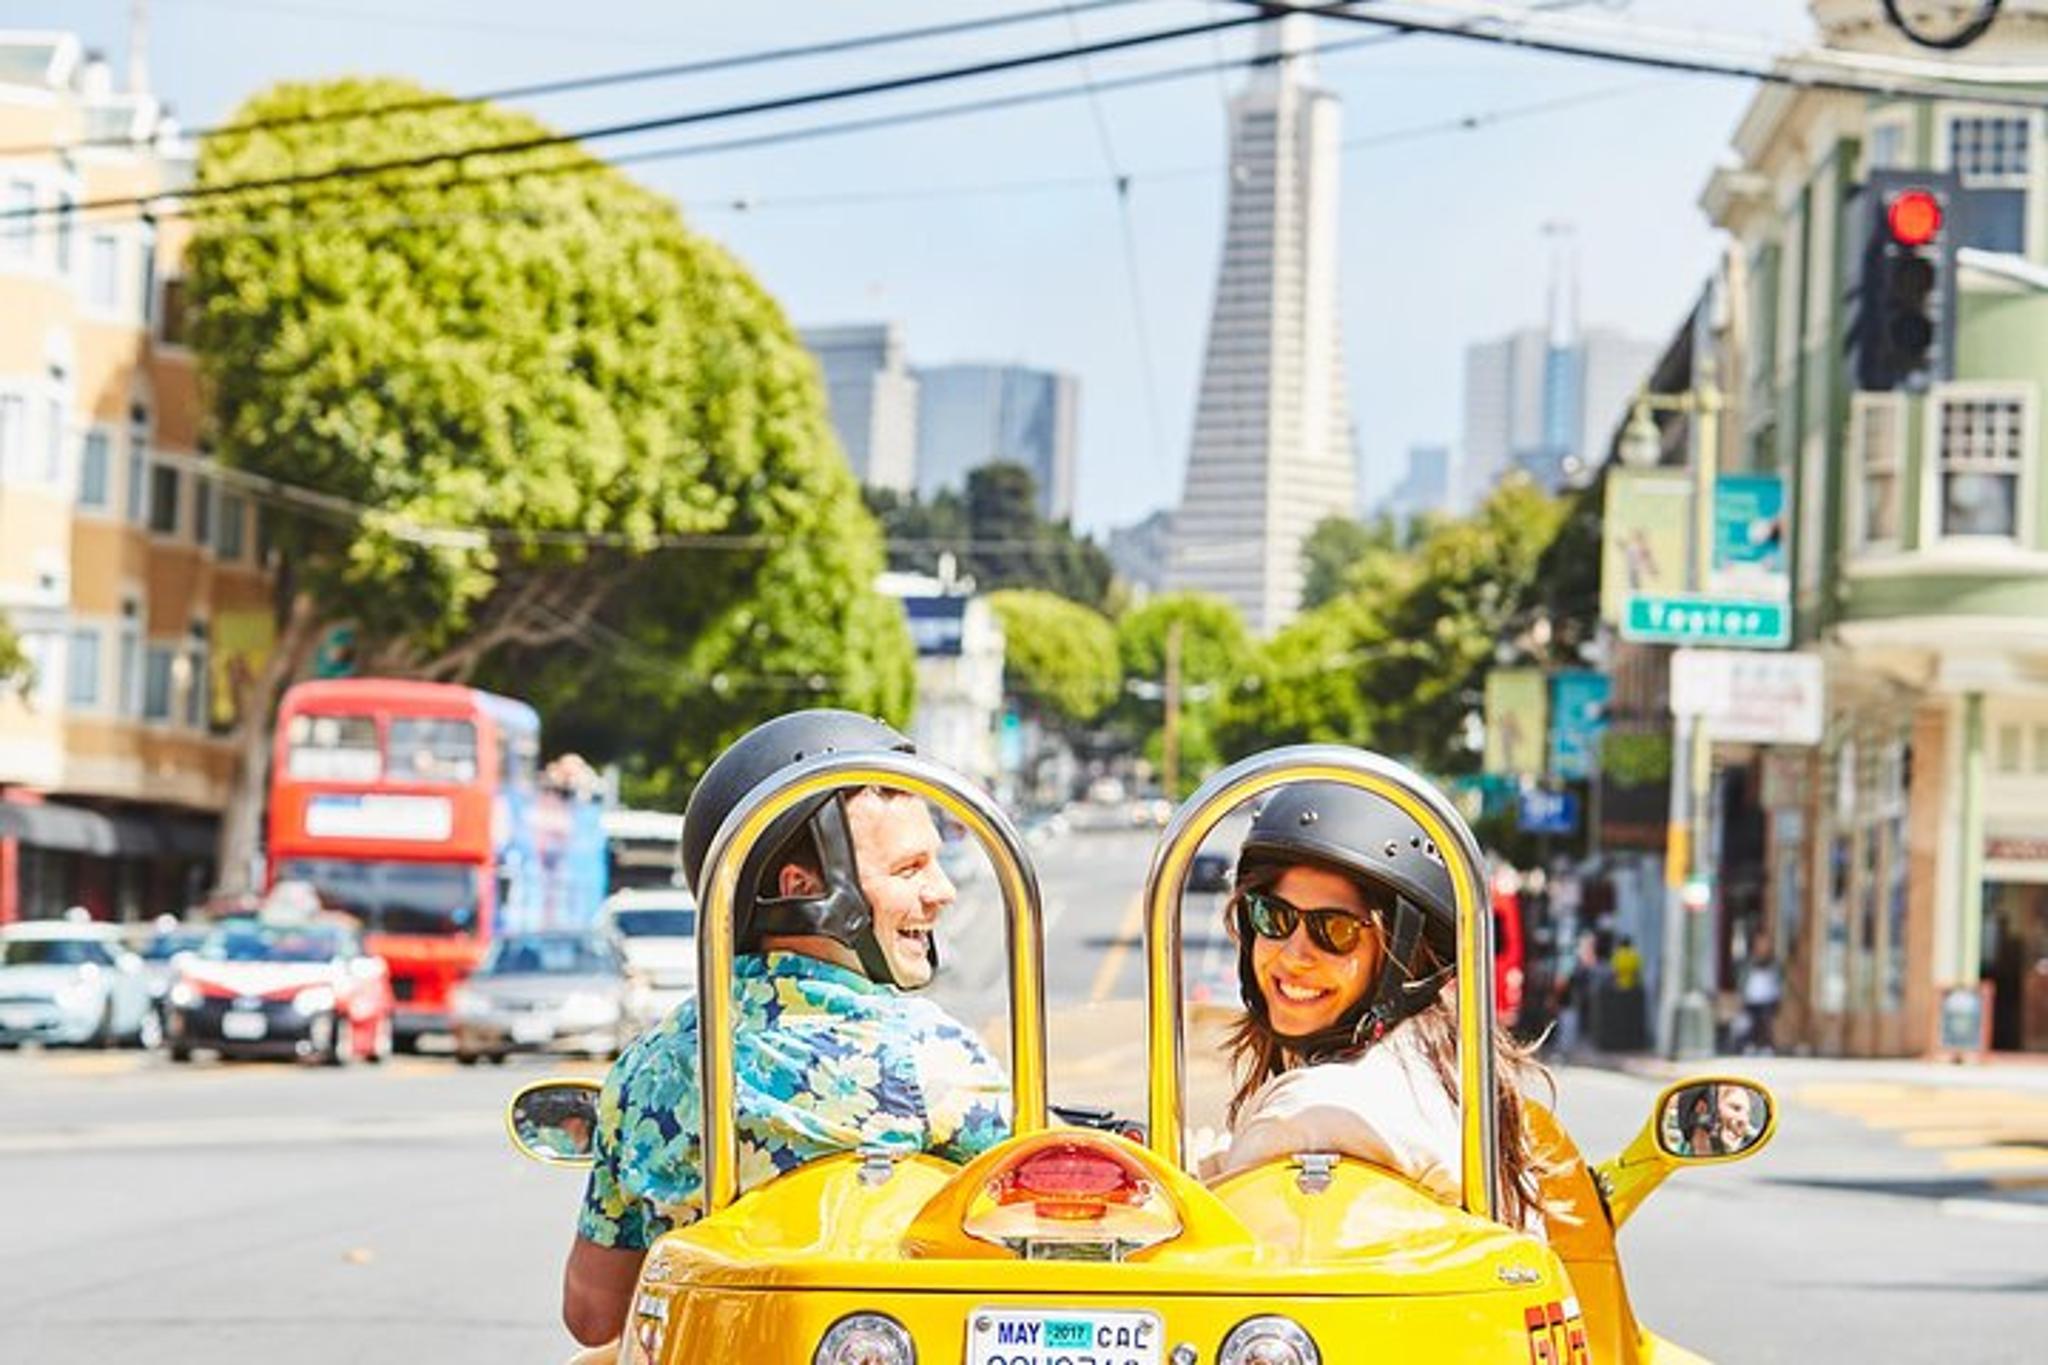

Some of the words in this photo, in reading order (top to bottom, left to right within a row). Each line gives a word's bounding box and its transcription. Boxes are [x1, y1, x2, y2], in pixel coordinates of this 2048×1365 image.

[997, 1321, 1041, 1344] MAY
[1052, 1326, 1085, 1340] 2017
[1097, 1326, 1148, 1349] CAL
